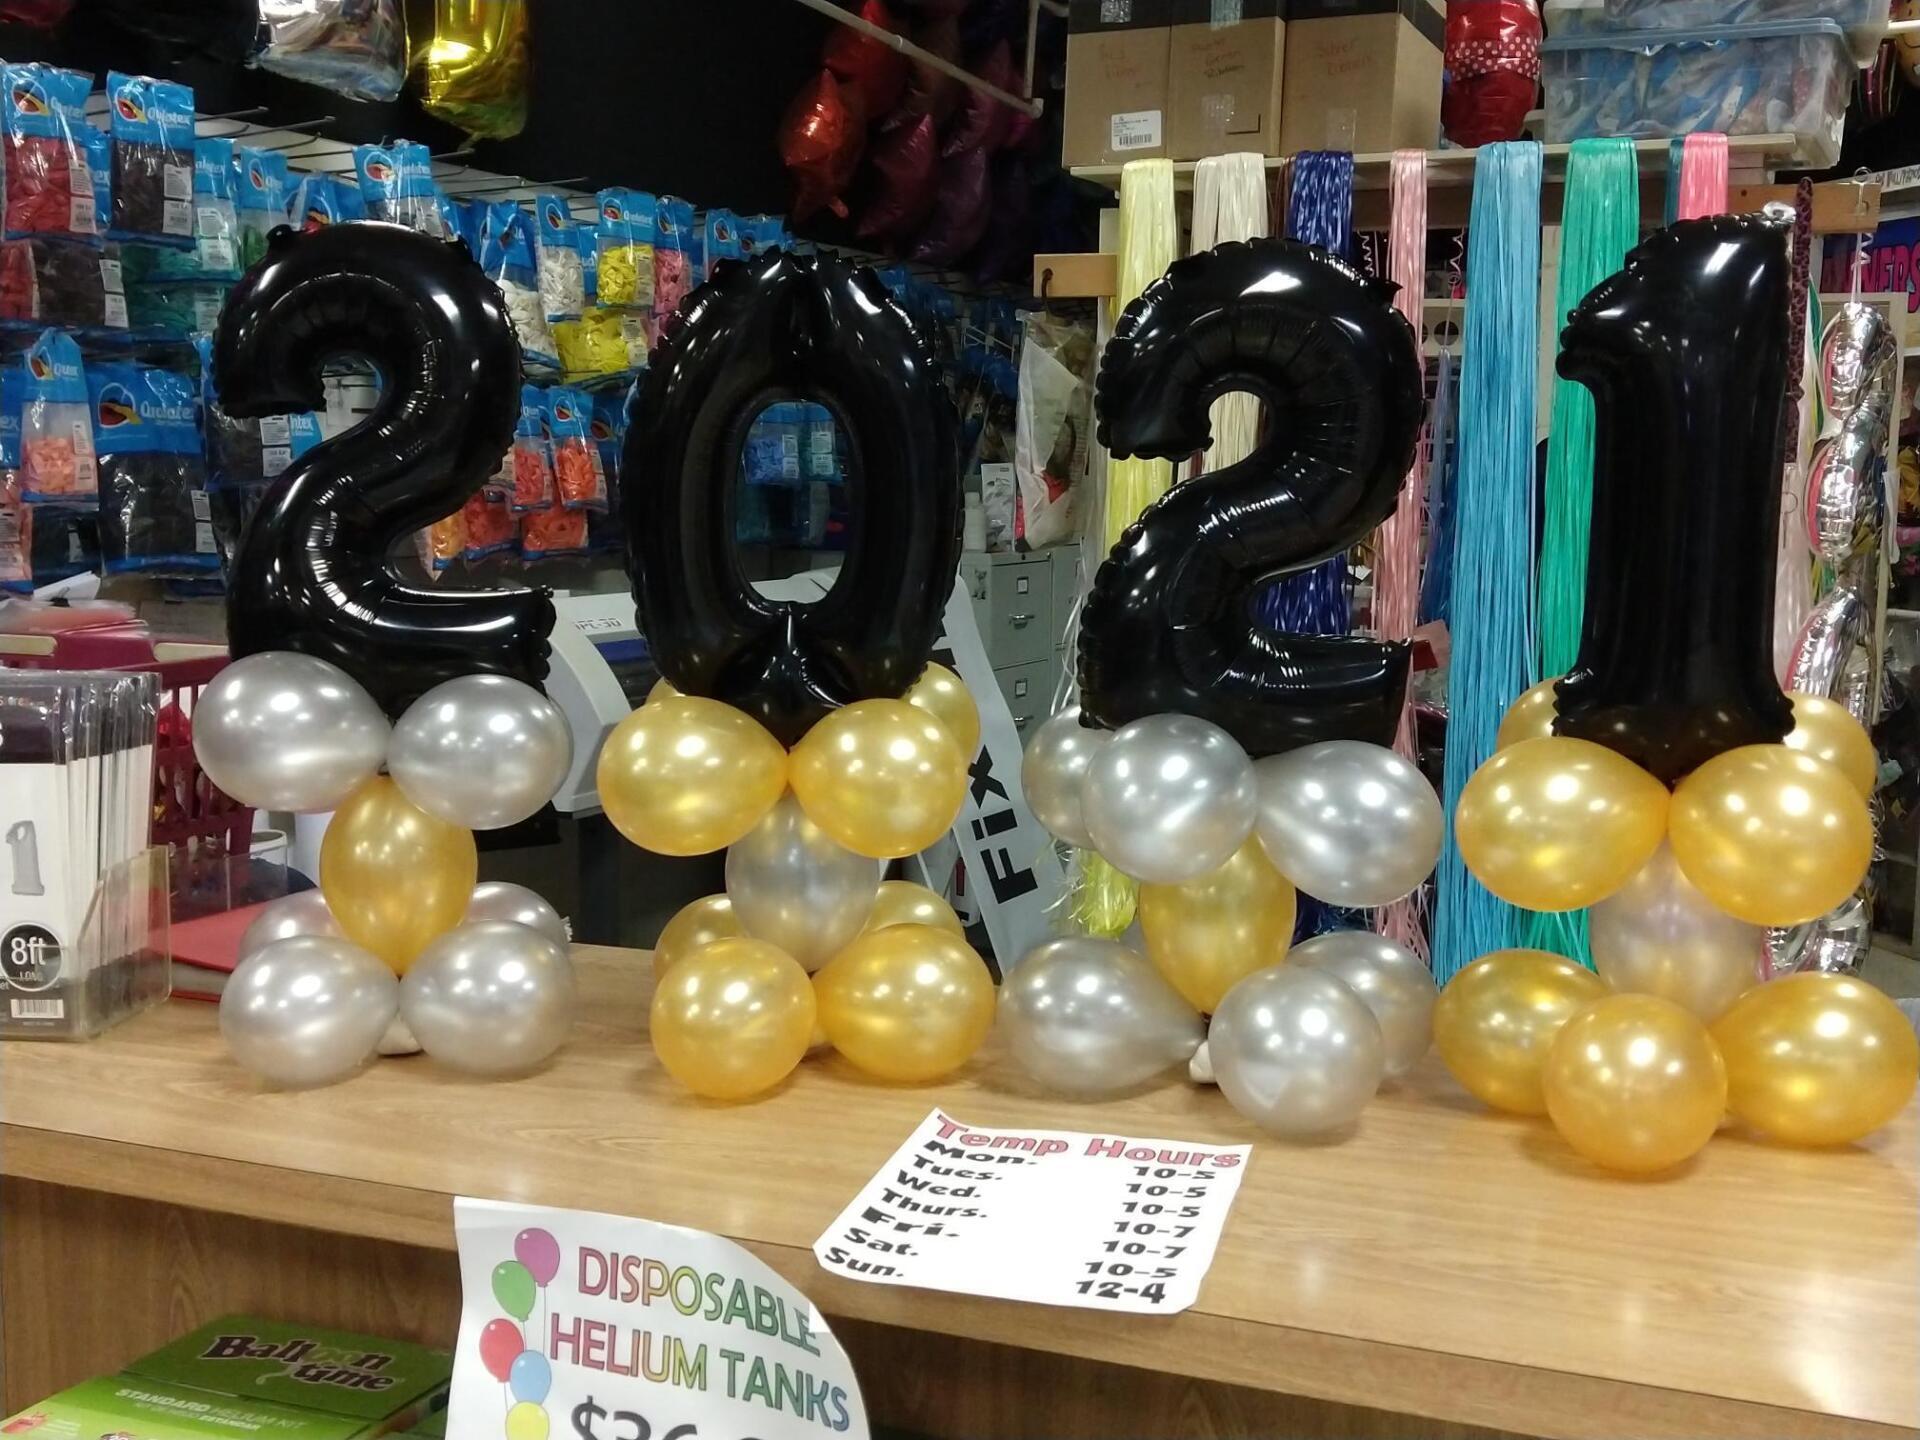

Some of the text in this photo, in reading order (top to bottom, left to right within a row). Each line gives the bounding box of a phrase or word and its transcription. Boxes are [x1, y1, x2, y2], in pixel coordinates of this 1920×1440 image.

[968, 744, 1038, 904] Fix
[10, 936, 46, 966] 8ft
[923, 1140, 1216, 1181] Mon. 10-5
[936, 1113, 1242, 1167] Temp Hours
[896, 1169, 1201, 1219] Wed. 10-5
[913, 1154, 1207, 1199] Tues. 10-5
[861, 1206, 1187, 1259] Fri. 10-7
[880, 1187, 1195, 1240] Thurs. 10-7
[825, 1247, 1166, 1304] Sun. 12-4
[844, 1227, 1177, 1279] Sat. 10-5
[577, 1244, 823, 1359] DISPOSABLE
[549, 1312, 851, 1432] HELIUM TANKS
[114, 1388, 211, 1413] STANDARD
